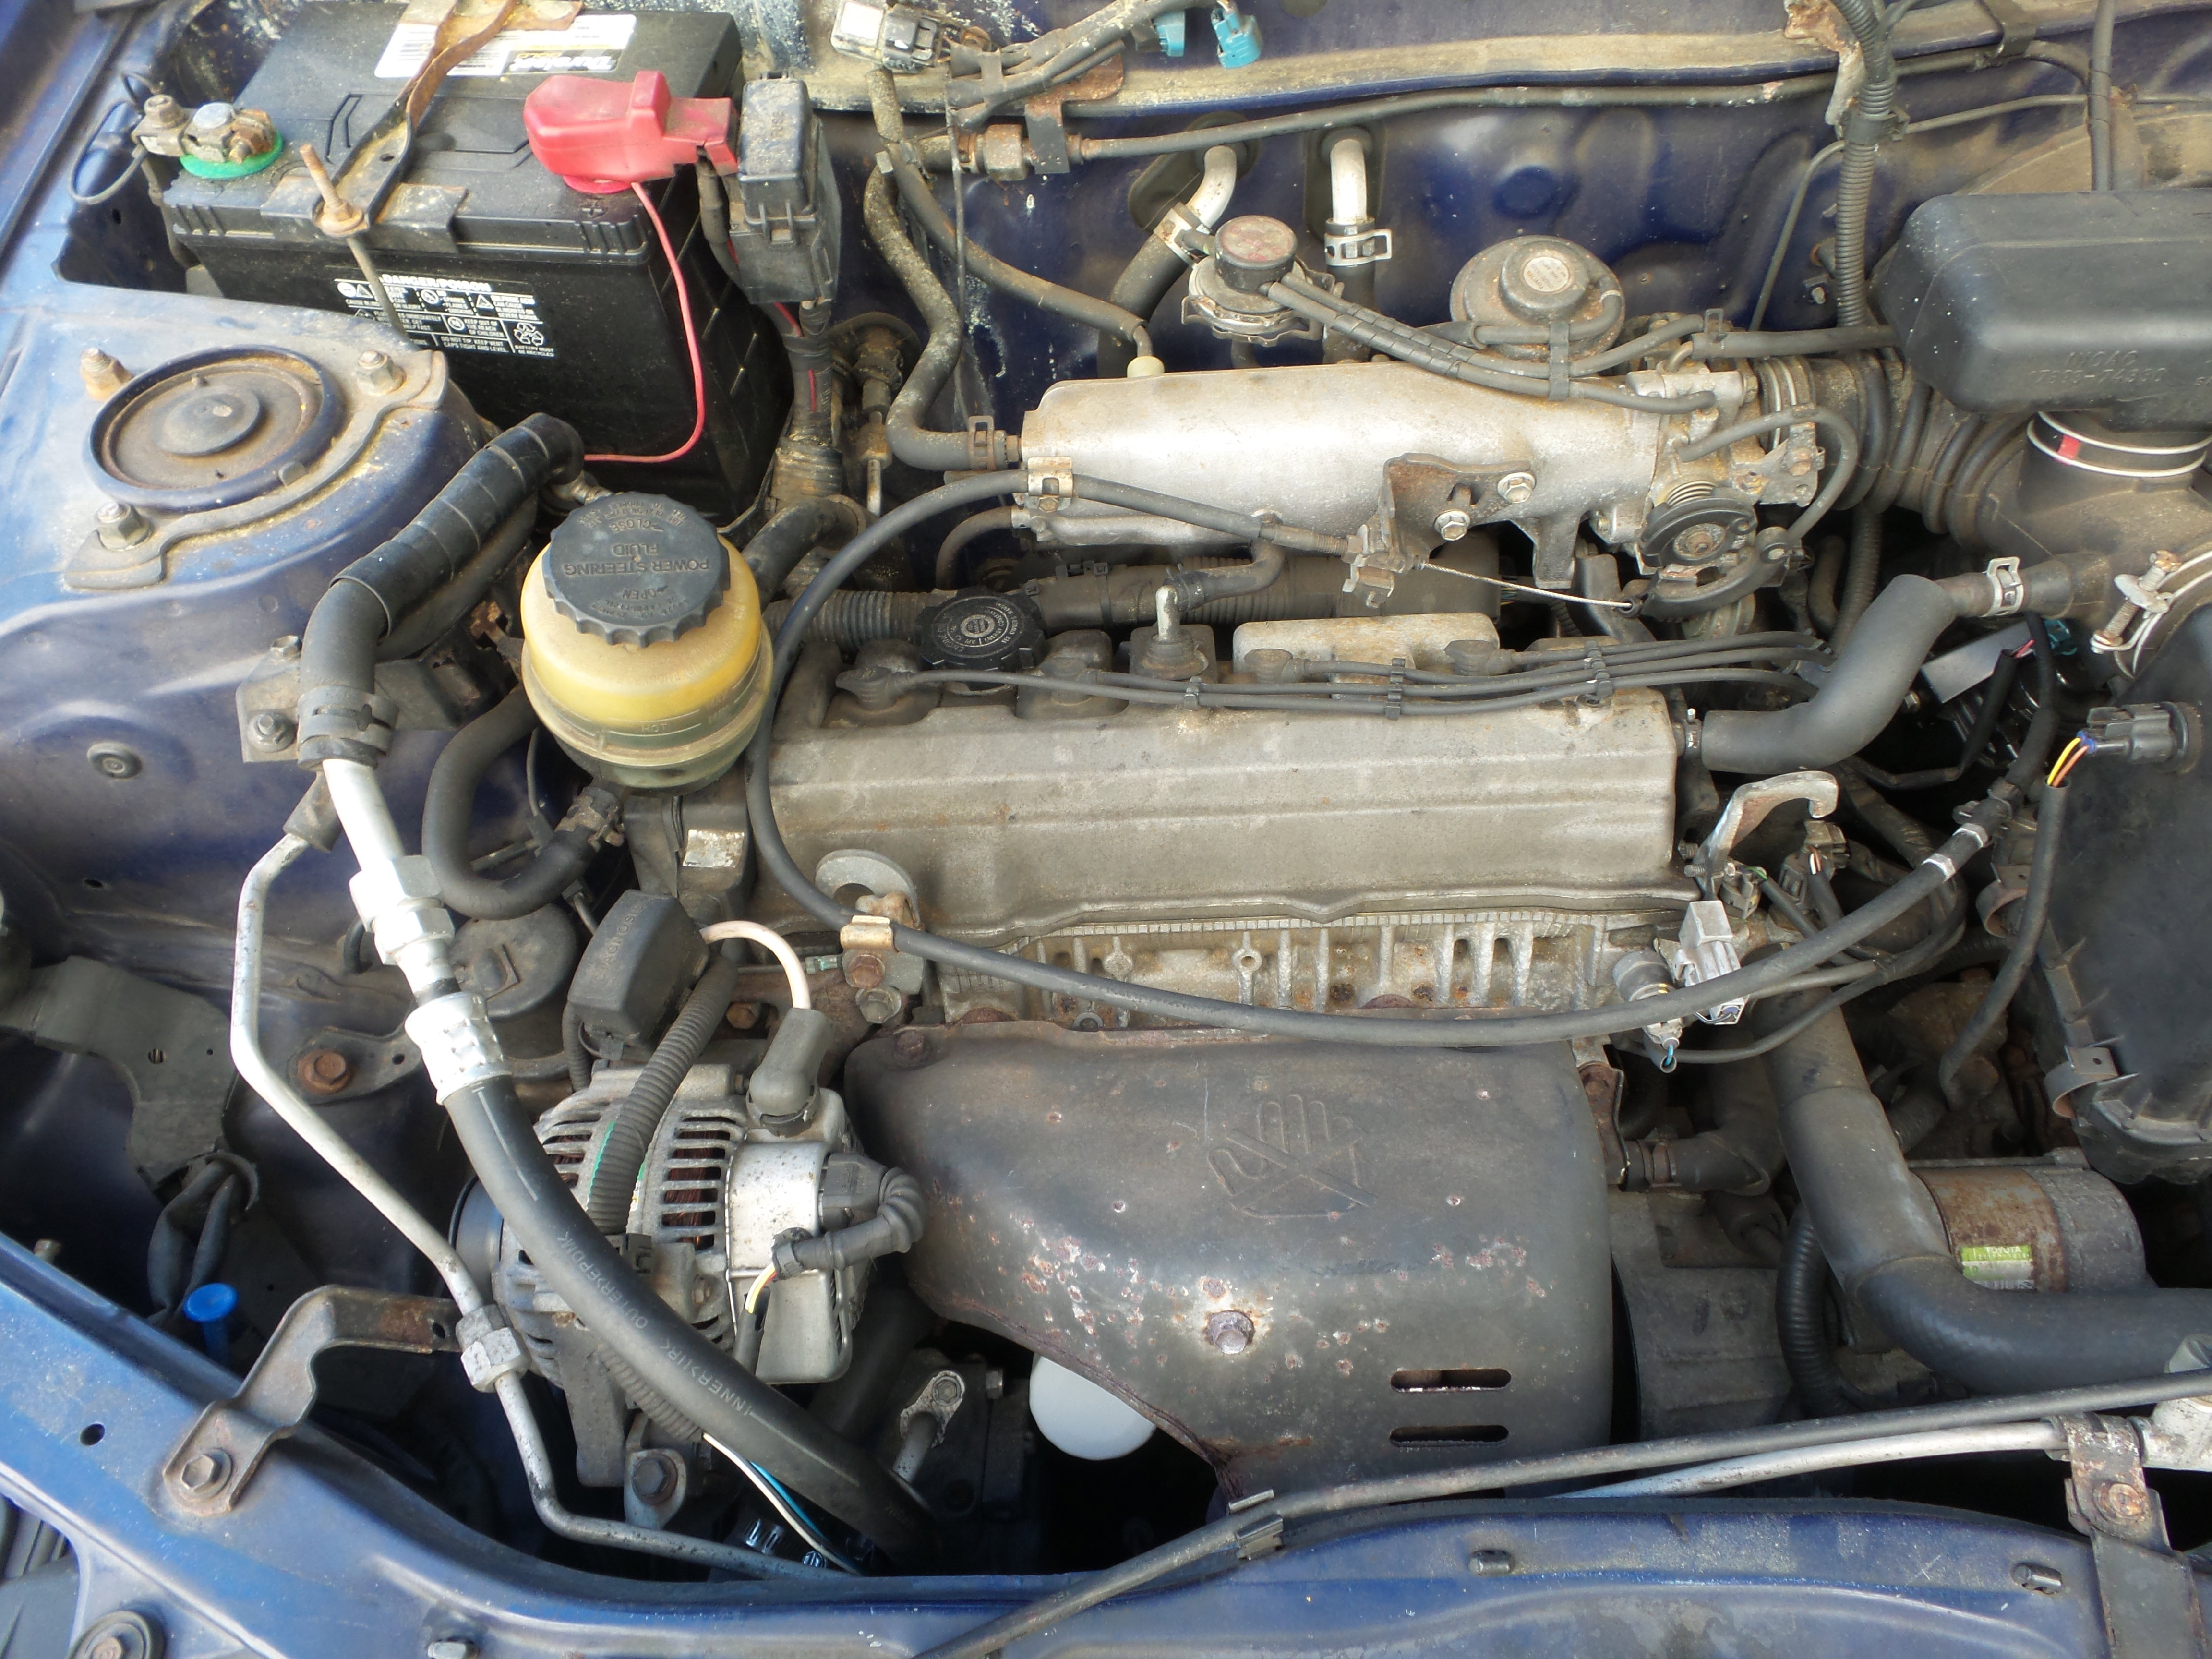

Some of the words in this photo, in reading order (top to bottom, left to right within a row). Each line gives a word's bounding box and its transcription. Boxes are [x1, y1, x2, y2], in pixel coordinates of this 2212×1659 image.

[509, 56, 613, 71] Duralast
[381, 273, 492, 292] DANGER/POISON
[609, 518, 652, 534] CLOSE
[611, 543, 660, 557] FLUID
[563, 561, 648, 577] STEERING
[650, 559, 710, 573] POWER
[622, 588, 657, 600] OPEN
[938, 633, 964, 652] ENGINE
[1985, 1246, 2022, 1254] TOYOTA
